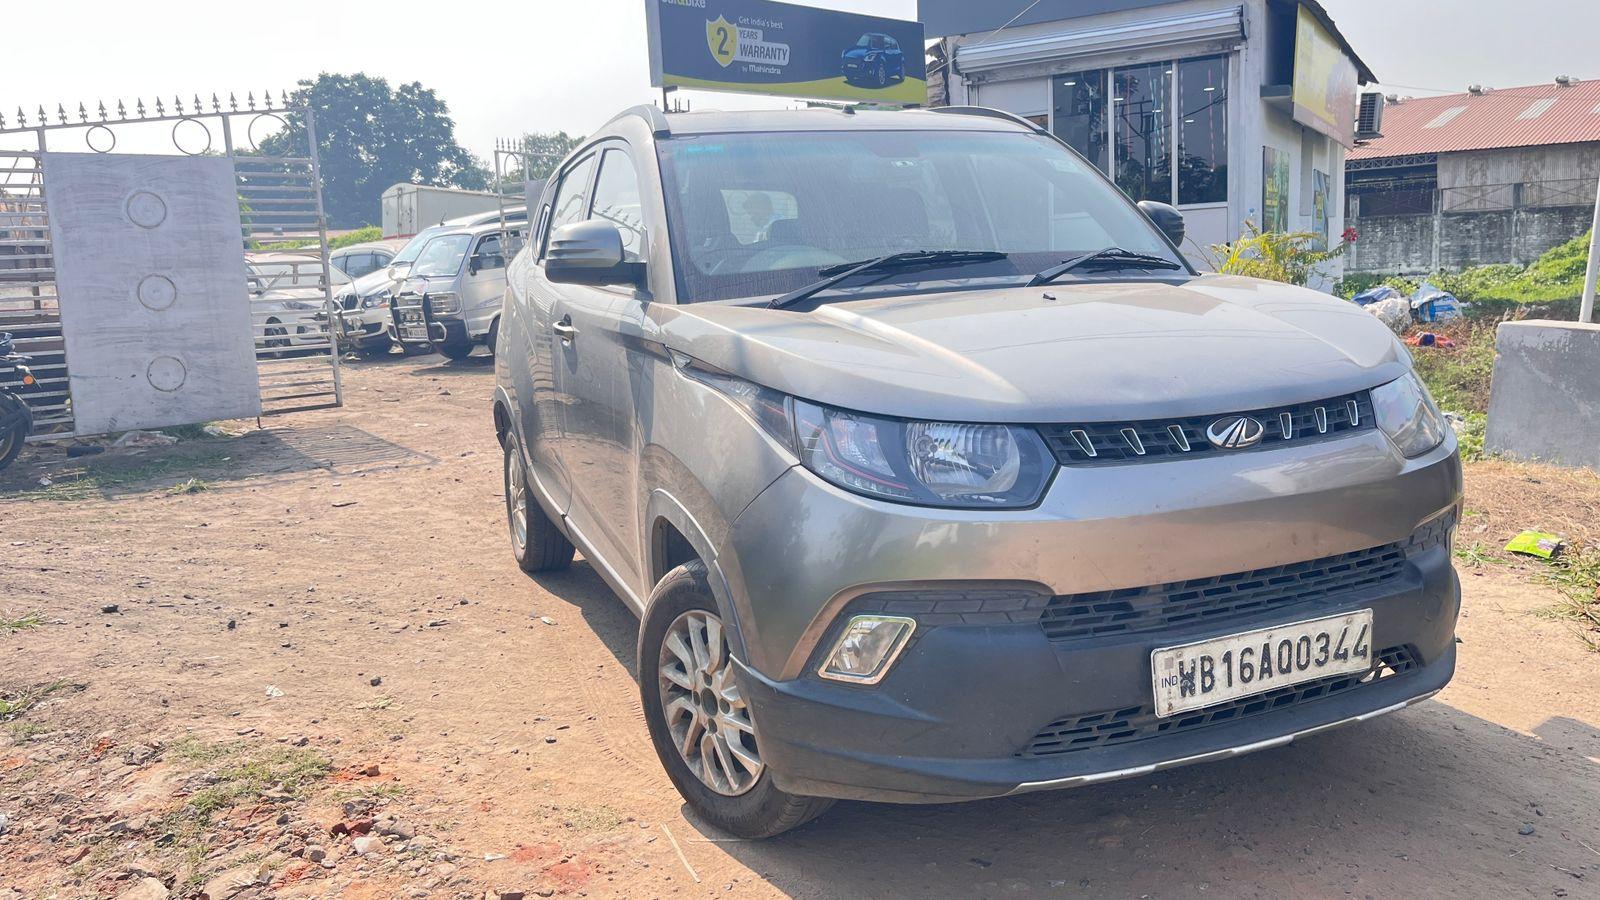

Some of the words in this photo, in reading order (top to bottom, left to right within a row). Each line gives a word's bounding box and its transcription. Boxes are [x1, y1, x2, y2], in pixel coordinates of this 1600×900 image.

[738, 16, 750, 25] Get
[750, 16, 769, 28] India's
[770, 20, 784, 30] best
[716, 26, 729, 56] 2
[739, 29, 758, 40] YEARS
[740, 43, 788, 61] WARRANTY
[748, 64, 781, 75] Mahindra
[1161, 675, 1178, 689] IND
